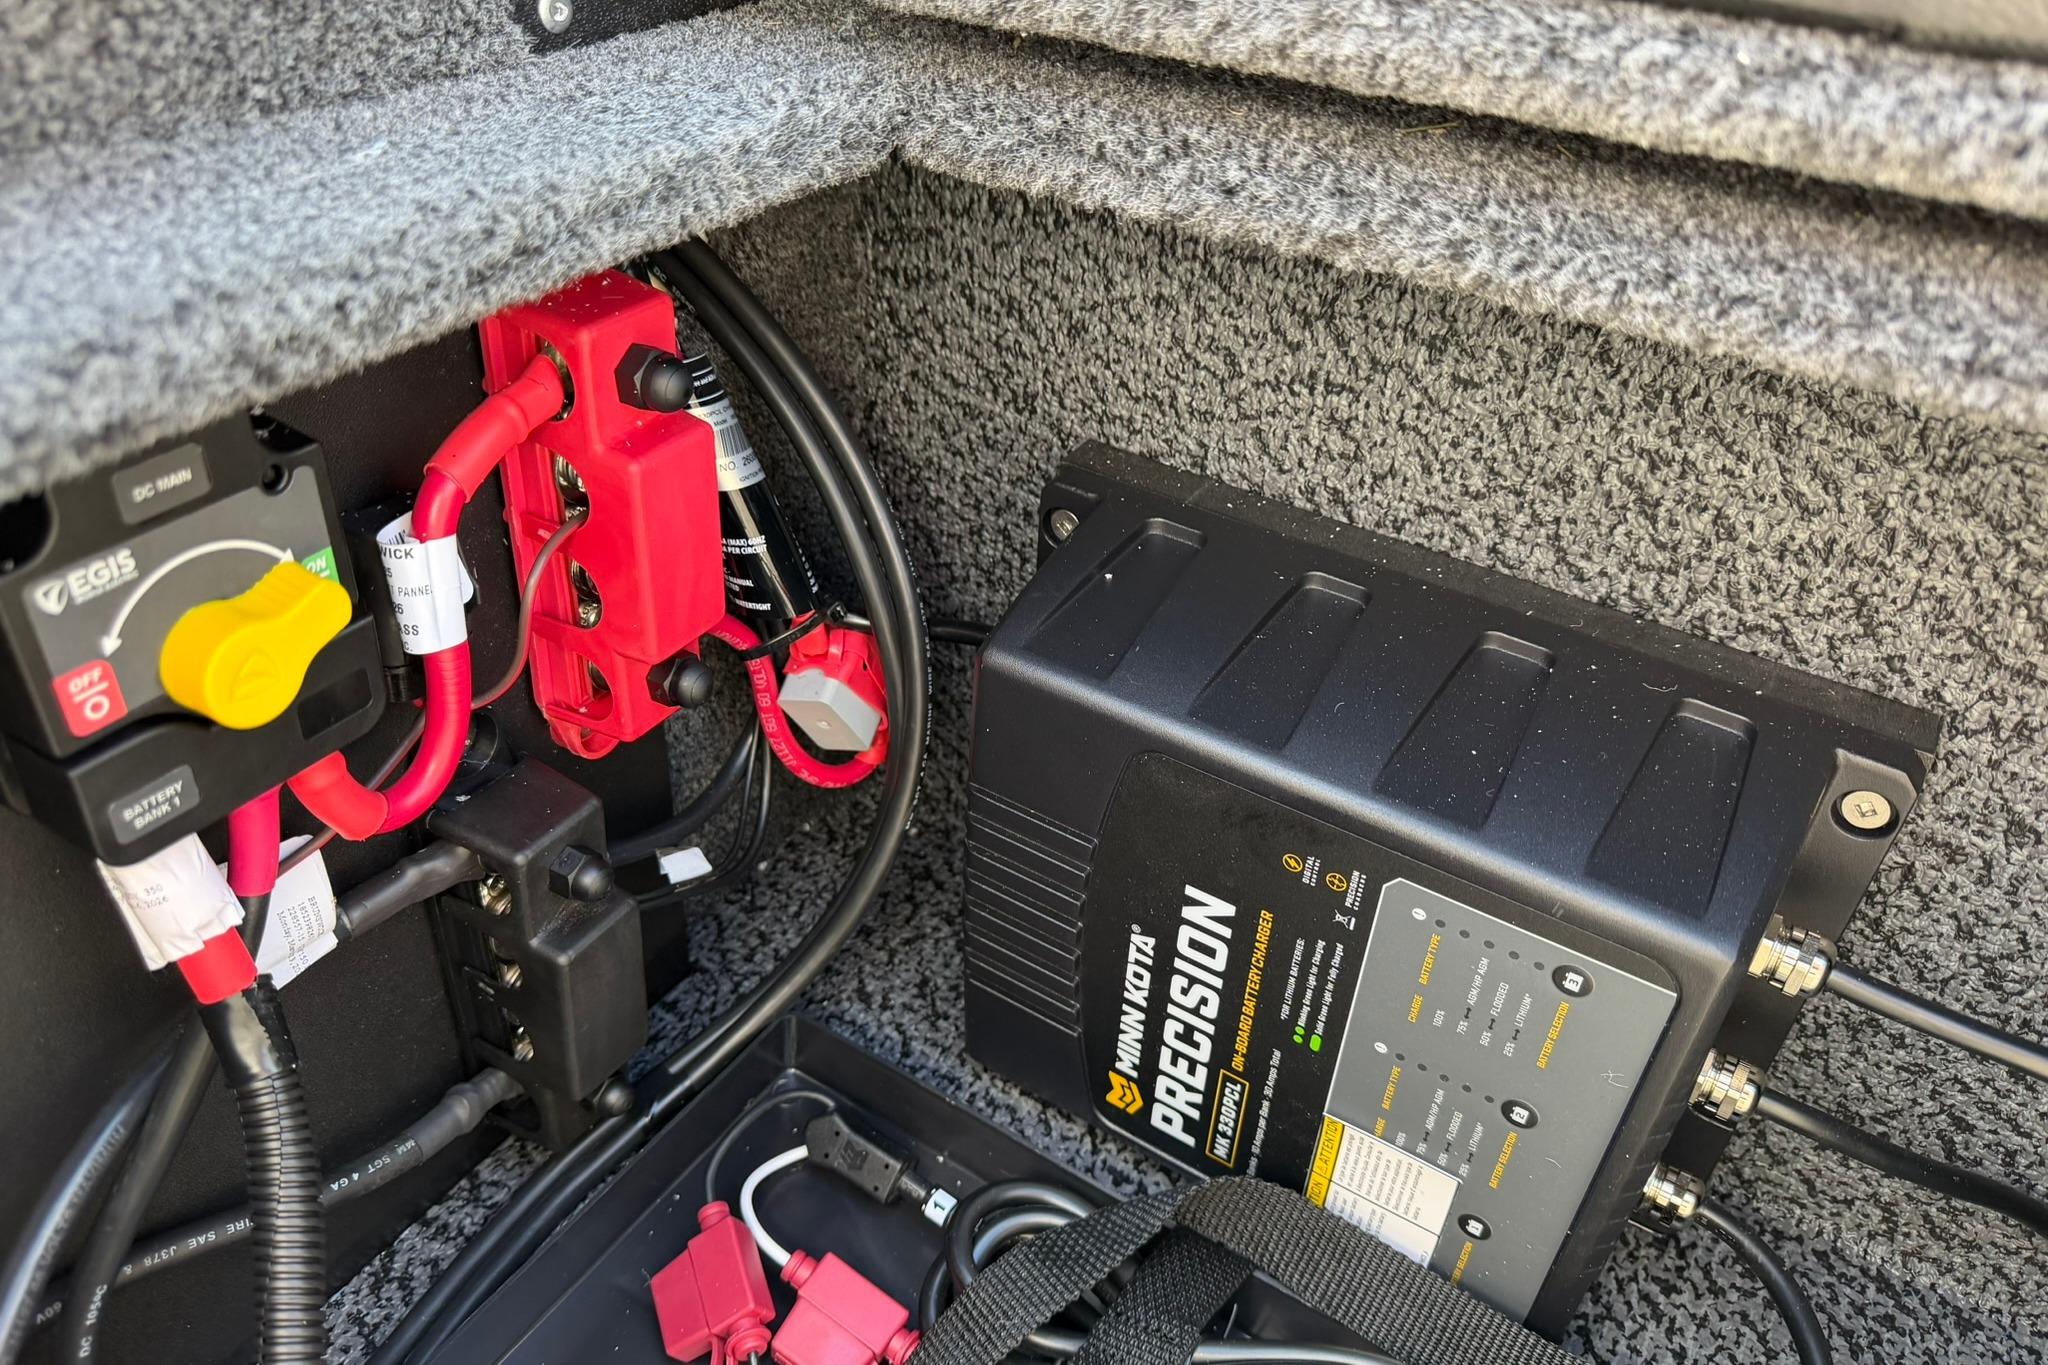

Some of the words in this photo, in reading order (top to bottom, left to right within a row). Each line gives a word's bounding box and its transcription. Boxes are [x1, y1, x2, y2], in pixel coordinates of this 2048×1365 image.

[131, 483, 155, 504] DC
[155, 467, 192, 492] MAIN
[727, 538, 747, 546] (MAX)
[747, 535, 766, 544] 60HZ
[740, 544, 766, 553] CIRCUIT
[67, 547, 137, 595] EGIS
[305, 555, 327, 574] ON
[67, 665, 101, 693] OFF
[123, 780, 182, 821] BATTERY
[133, 801, 171, 830] BANK
[172, 795, 182, 807] 1
[1301, 854, 1315, 884] DIGITAL
[1309, 858, 1321, 886] CONTROL
[1344, 869, 1360, 907] PRECISION
[1250, 909, 1276, 970] CHARGER
[1289, 936, 1306, 976] BATTERIES:
[1311, 939, 1326, 964] Charging
[1330, 942, 1344, 967] Charged
[1308, 963, 1318, 974] for
[1327, 966, 1339, 982] Fully
[1407, 993, 1423, 1023] CHARGE
[1418, 952, 1435, 985] BATTERY
[1427, 932, 1441, 954] TYPE
[1239, 962, 1264, 1016] BATTERY
[1283, 975, 1297, 1004] LITHIUM
[1305, 973, 1317, 988] Light
[1324, 980, 1334, 991] for
[1567, 977, 1580, 987] 3
[1302, 987, 1313, 1005] Green
[1321, 989, 1332, 1005] Light
[1456, 1019, 1469, 1035] 75%
[1466, 974, 1484, 1006] AGM/HP
[1476, 956, 1490, 975] AGM
[1490, 981, 1509, 1016] FLOODED
[1149, 883, 1238, 1148] PRECISION
[1297, 1004, 1311, 1027] Blinking
[1317, 1003, 1328, 1020] Green
[1431, 1008, 1445, 1027] 100%
[1313, 1019, 1324, 1035] Solid
[1536, 1037, 1555, 1068] BATTERY
[1548, 1001, 1570, 1040] SELECTION
[1114, 1003, 1148, 1078] MINN
[1227, 1012, 1255, 1071] ON-BOARD
[1502, 1040, 1515, 1056] 25%
[1267, 1047, 1283, 1076] Total
[1265, 1066, 1279, 1087] Amps
[1388, 1064, 1401, 1083] TYPE
[1262, 1085, 1274, 1098] 30
[1381, 1081, 1397, 1111] BATTERY
[1215, 1078, 1243, 1137] 330PCL
[1258, 1099, 1271, 1118] Bank
[1514, 1110, 1526, 1119] 2
[1257, 1116, 1268, 1129] per
[1415, 1141, 1427, 1155] 75%
[1424, 1102, 1440, 1130] AGM/HP
[1432, 1088, 1445, 1105] AGM
[1445, 1110, 1464, 1141] FLOODED
[1210, 1131, 1230, 1160] MK
[1252, 1127, 1265, 1146] Amps
[1319, 1118, 1340, 1166] ATTENTION
[1250, 1144, 1260, 1153] 10
[1487, 1161, 1506, 1189] BATTERY
[1497, 1130, 1518, 1163] SELECTION
[366, 1154, 391, 1173] SGT
[1458, 1162, 1470, 1177] 25%
[329, 1176, 349, 1192] GA
[351, 1170, 361, 1181] 4
[930, 1198, 946, 1214] 1
[225, 1217, 253, 1234] IRE
[186, 1230, 216, 1248] SAE
[143, 1244, 177, 1266] J378
[1455, 1240, 1473, 1269] SELECTION
[35, 1300, 63, 1325] 60V
[77, 1336, 92, 1356] DC
